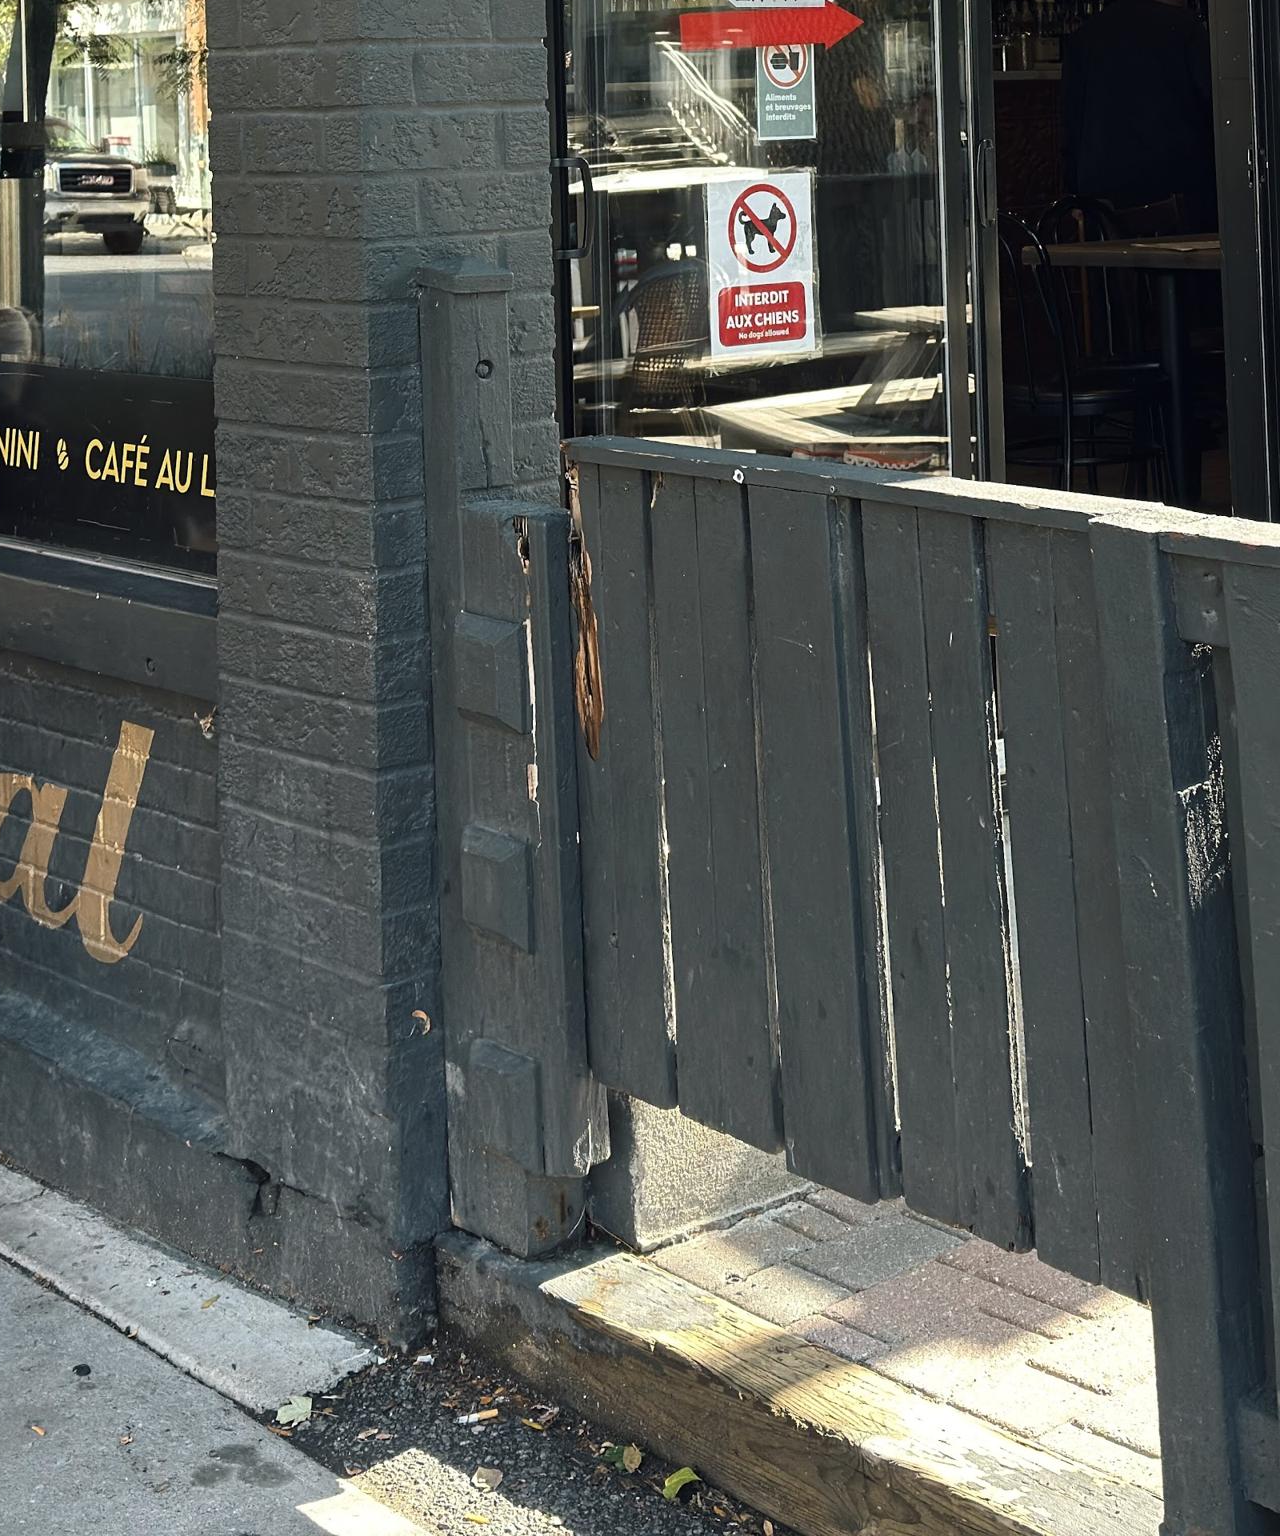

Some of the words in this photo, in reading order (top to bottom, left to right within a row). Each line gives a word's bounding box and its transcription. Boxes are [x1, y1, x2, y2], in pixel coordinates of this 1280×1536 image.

[765, 93, 797, 102] Aliments
[775, 103, 811, 112] breuvages
[735, 290, 789, 307] INTERDIT
[726, 313, 753, 329] AUX
[754, 310, 799, 326] CHIENS
[738, 331, 748, 340] No
[749, 329, 764, 340] dogs
[765, 327, 790, 338] allowed
[85, 434, 151, 487] CAFÉ
[155, 448, 194, 494] AU
